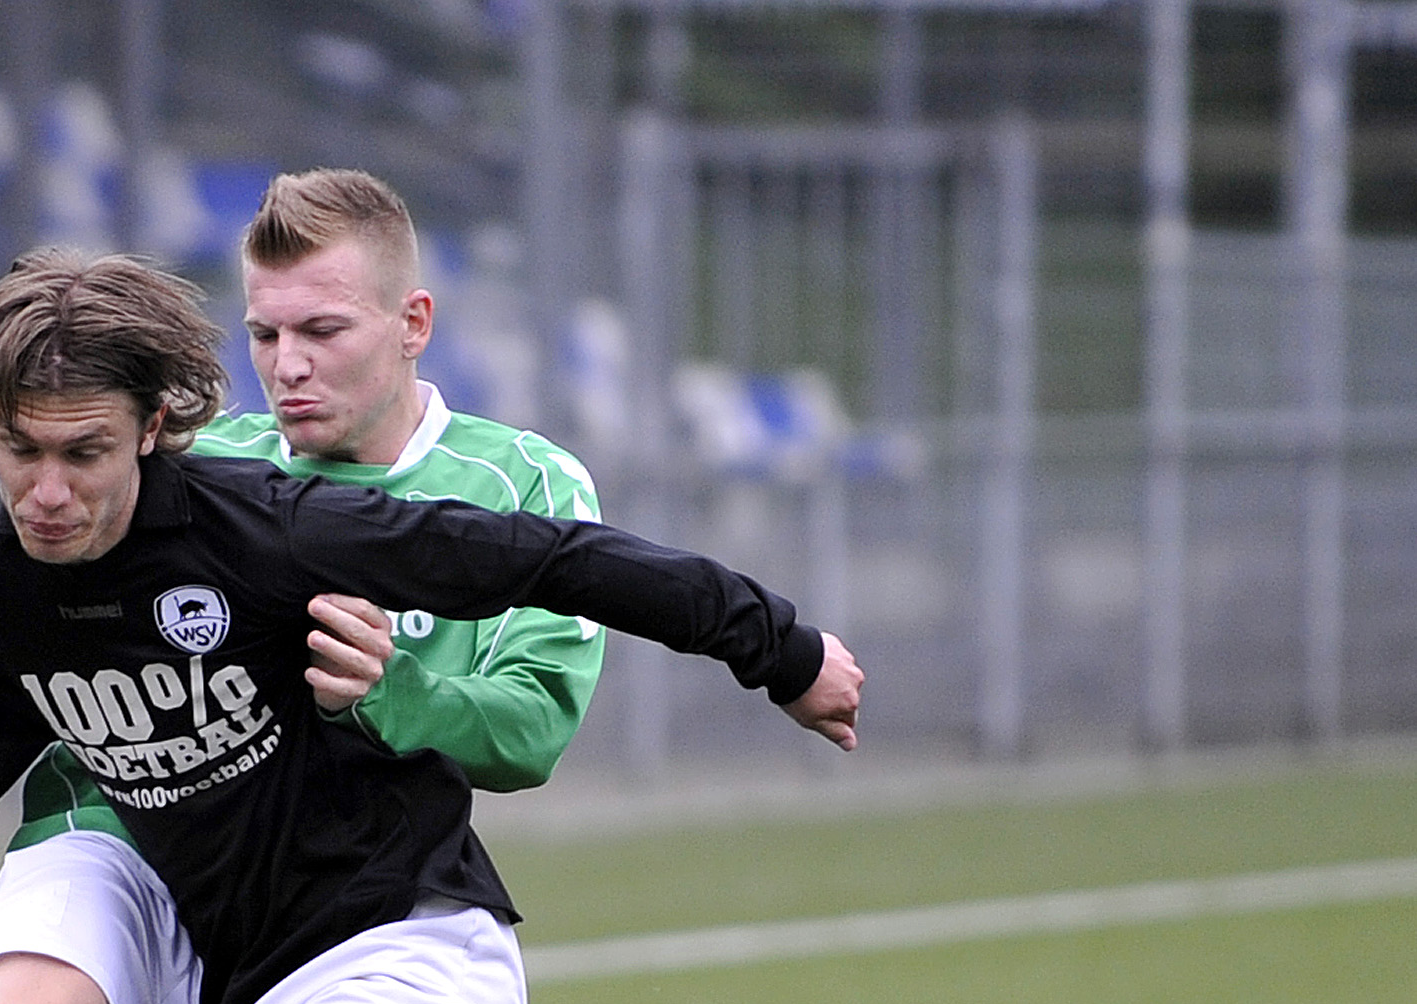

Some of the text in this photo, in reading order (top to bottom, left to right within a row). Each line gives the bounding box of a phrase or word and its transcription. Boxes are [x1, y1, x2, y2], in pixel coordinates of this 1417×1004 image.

[58, 601, 123, 619] hummel
[174, 623, 217, 647] WSV
[20, 654, 259, 745] 100%
